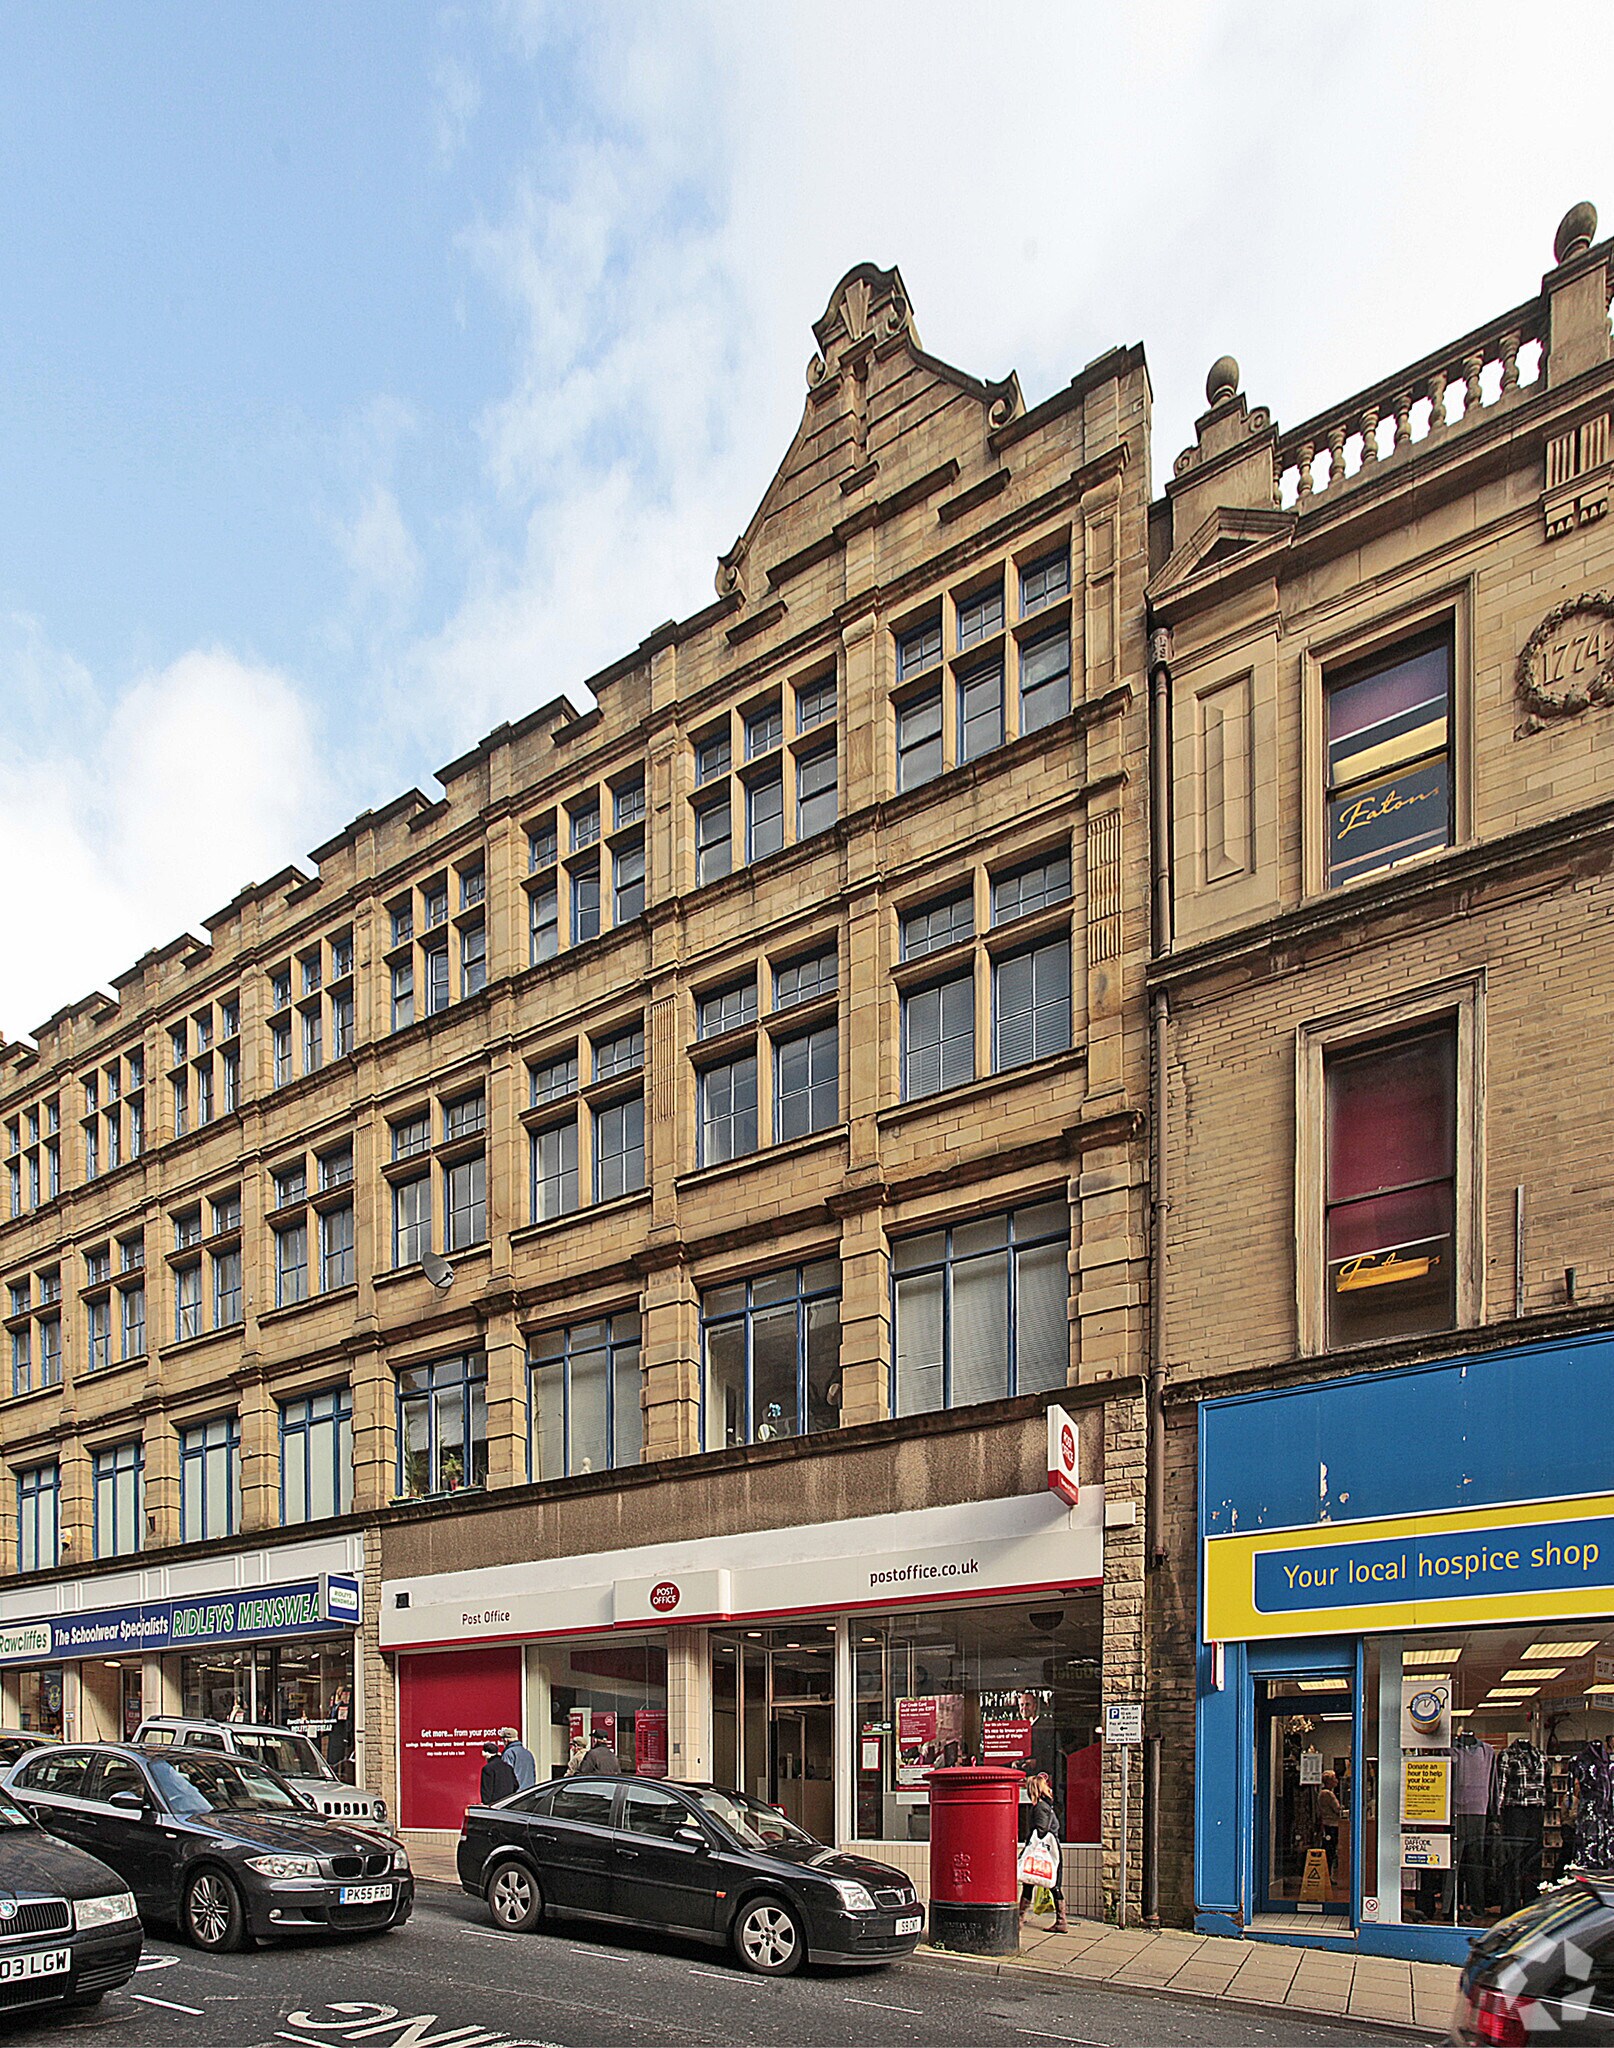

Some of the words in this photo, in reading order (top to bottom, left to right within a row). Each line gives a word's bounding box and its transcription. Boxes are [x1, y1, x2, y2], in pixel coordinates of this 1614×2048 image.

[1541, 624, 1611, 686] 1774
[1283, 1564, 1339, 1588] Your
[1348, 1554, 1406, 1583] local
[1418, 1547, 1520, 1580] hospice
[1530, 1540, 1599, 1570] shop
[870, 1559, 979, 1587] postoffice.co.uk
[656, 1586, 674, 1596] POST
[652, 1595, 677, 1605] OFFICE
[172, 1603, 234, 1638] RIDLEYS
[237, 1593, 322, 1631] MENSWEA
[462, 1612, 482, 1625] Post
[484, 1610, 510, 1623] Office
[55, 1629, 70, 1647] The
[71, 1623, 119, 1645] Schoolwear
[120, 1615, 169, 1642] Specialists
[1111, 1709, 1118, 1719] P
[421, 1729, 432, 1738] Get
[454, 1728, 468, 1737] from
[469, 1729, 482, 1738] your
[483, 1728, 497, 1738] post
[1407, 1784, 1430, 1792] hospice
[347, 1887, 373, 1901] PK55
[30, 1951, 67, 1974] LGW
